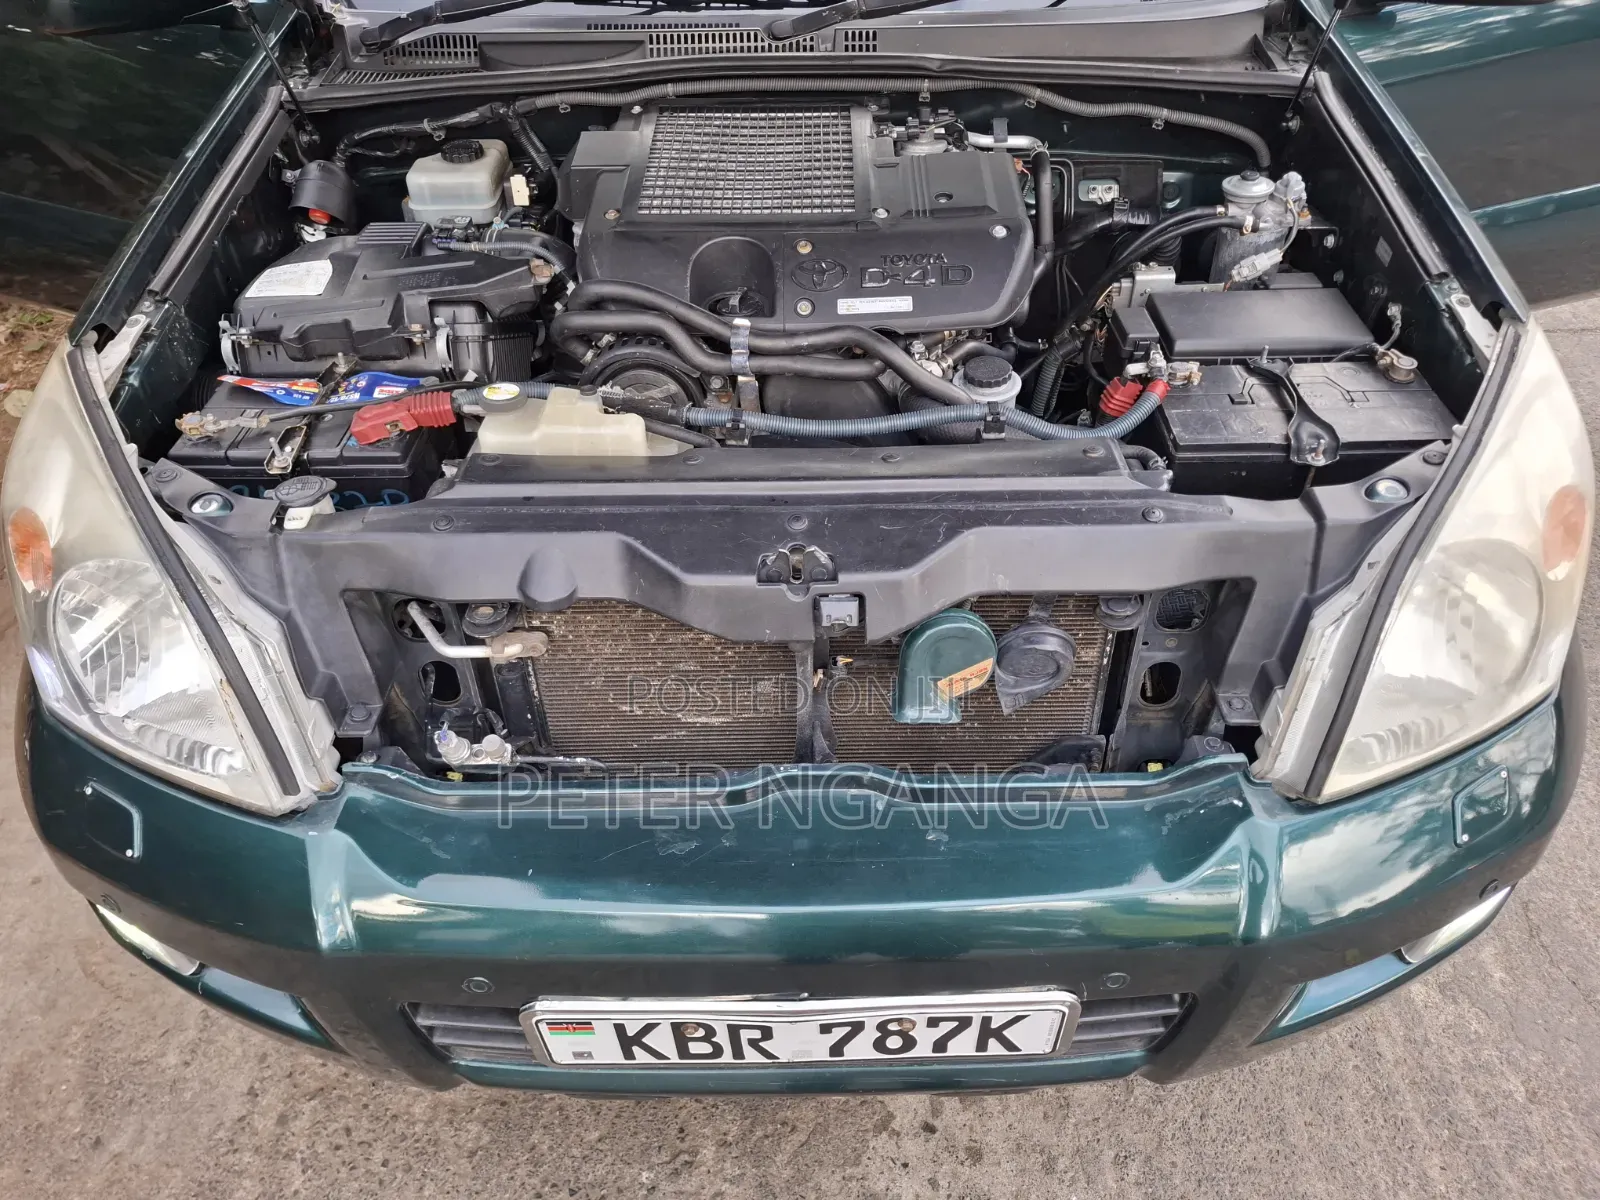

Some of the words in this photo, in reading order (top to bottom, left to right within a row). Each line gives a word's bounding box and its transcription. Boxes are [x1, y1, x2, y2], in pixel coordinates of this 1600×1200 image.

[880, 253, 948, 267] TOYOTA
[613, 1021, 780, 1061] KBR
[819, 1014, 1041, 1058] 787K
